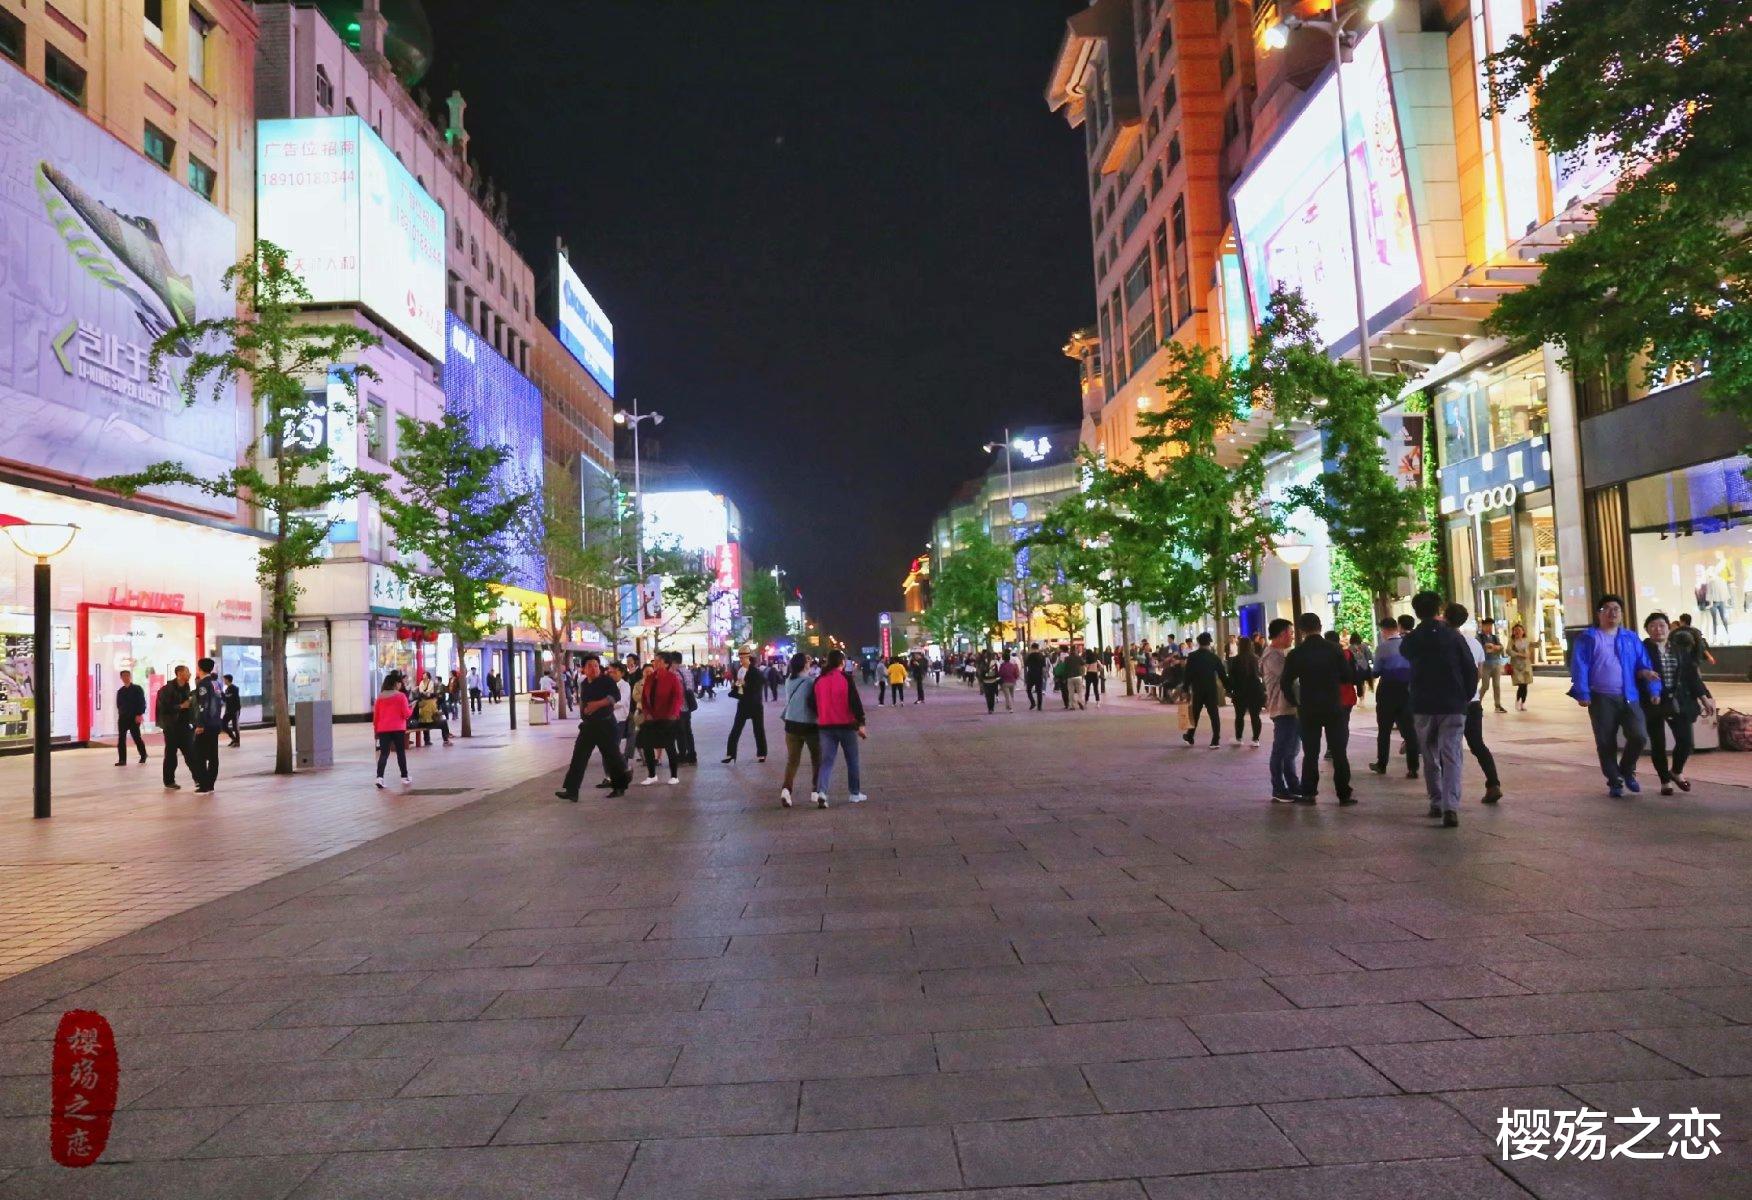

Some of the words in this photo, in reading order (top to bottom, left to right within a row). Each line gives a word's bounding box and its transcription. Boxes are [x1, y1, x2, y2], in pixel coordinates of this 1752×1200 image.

[264, 141, 354, 157] 广告位招商
[108, 586, 185, 612] LI-NING
